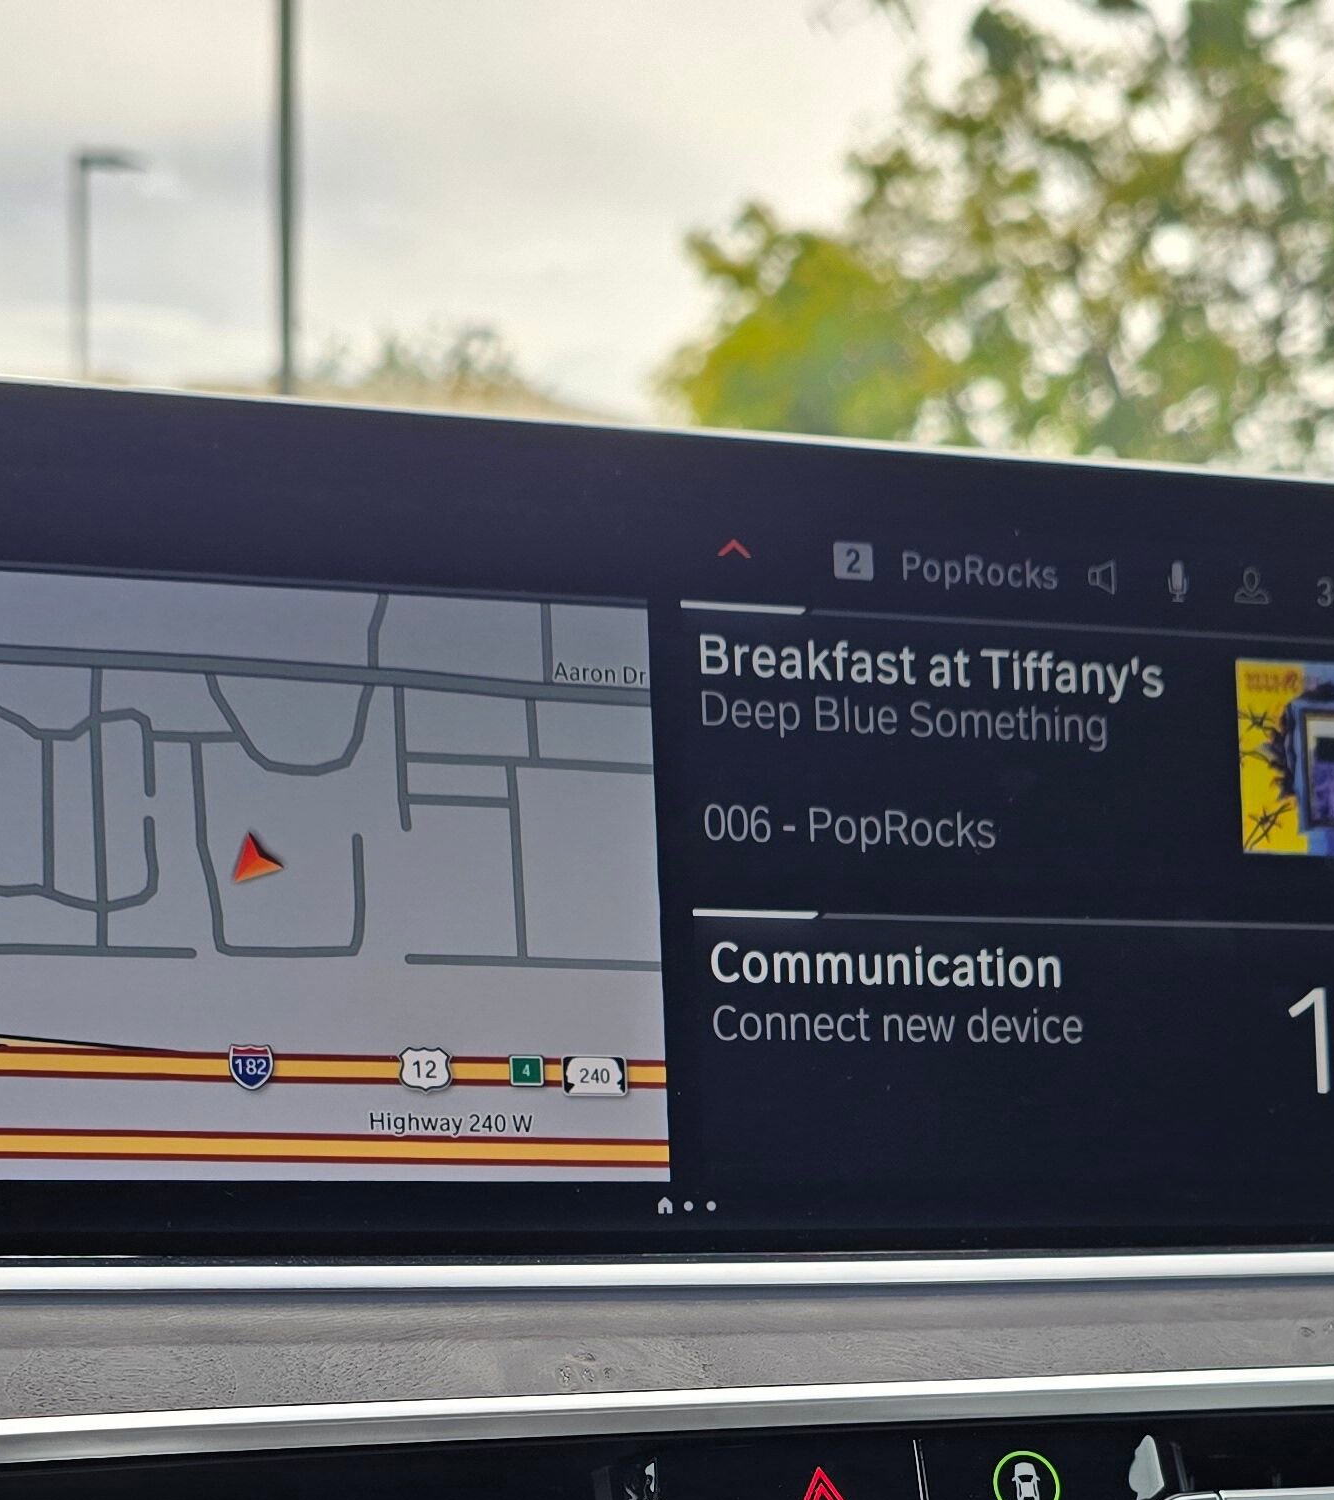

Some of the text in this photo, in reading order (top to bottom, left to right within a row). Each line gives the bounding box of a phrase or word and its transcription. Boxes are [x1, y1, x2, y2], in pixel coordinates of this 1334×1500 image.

[845, 549, 1059, 591] 2 PopRocks
[554, 661, 647, 685] Aaron Dr
[698, 634, 1165, 704] Breakfast at Tiffany's
[700, 690, 1109, 752] Deep Blue Something
[703, 803, 772, 844] 006
[808, 806, 998, 853] PopRocks
[710, 941, 1063, 989] Communication
[712, 1004, 1084, 1045] Connect new device
[234, 1057, 267, 1076] 182
[412, 1059, 438, 1079] 12
[521, 1064, 531, 1078] 4
[579, 1067, 611, 1085] 240
[369, 1112, 533, 1137] Highway 240 W
